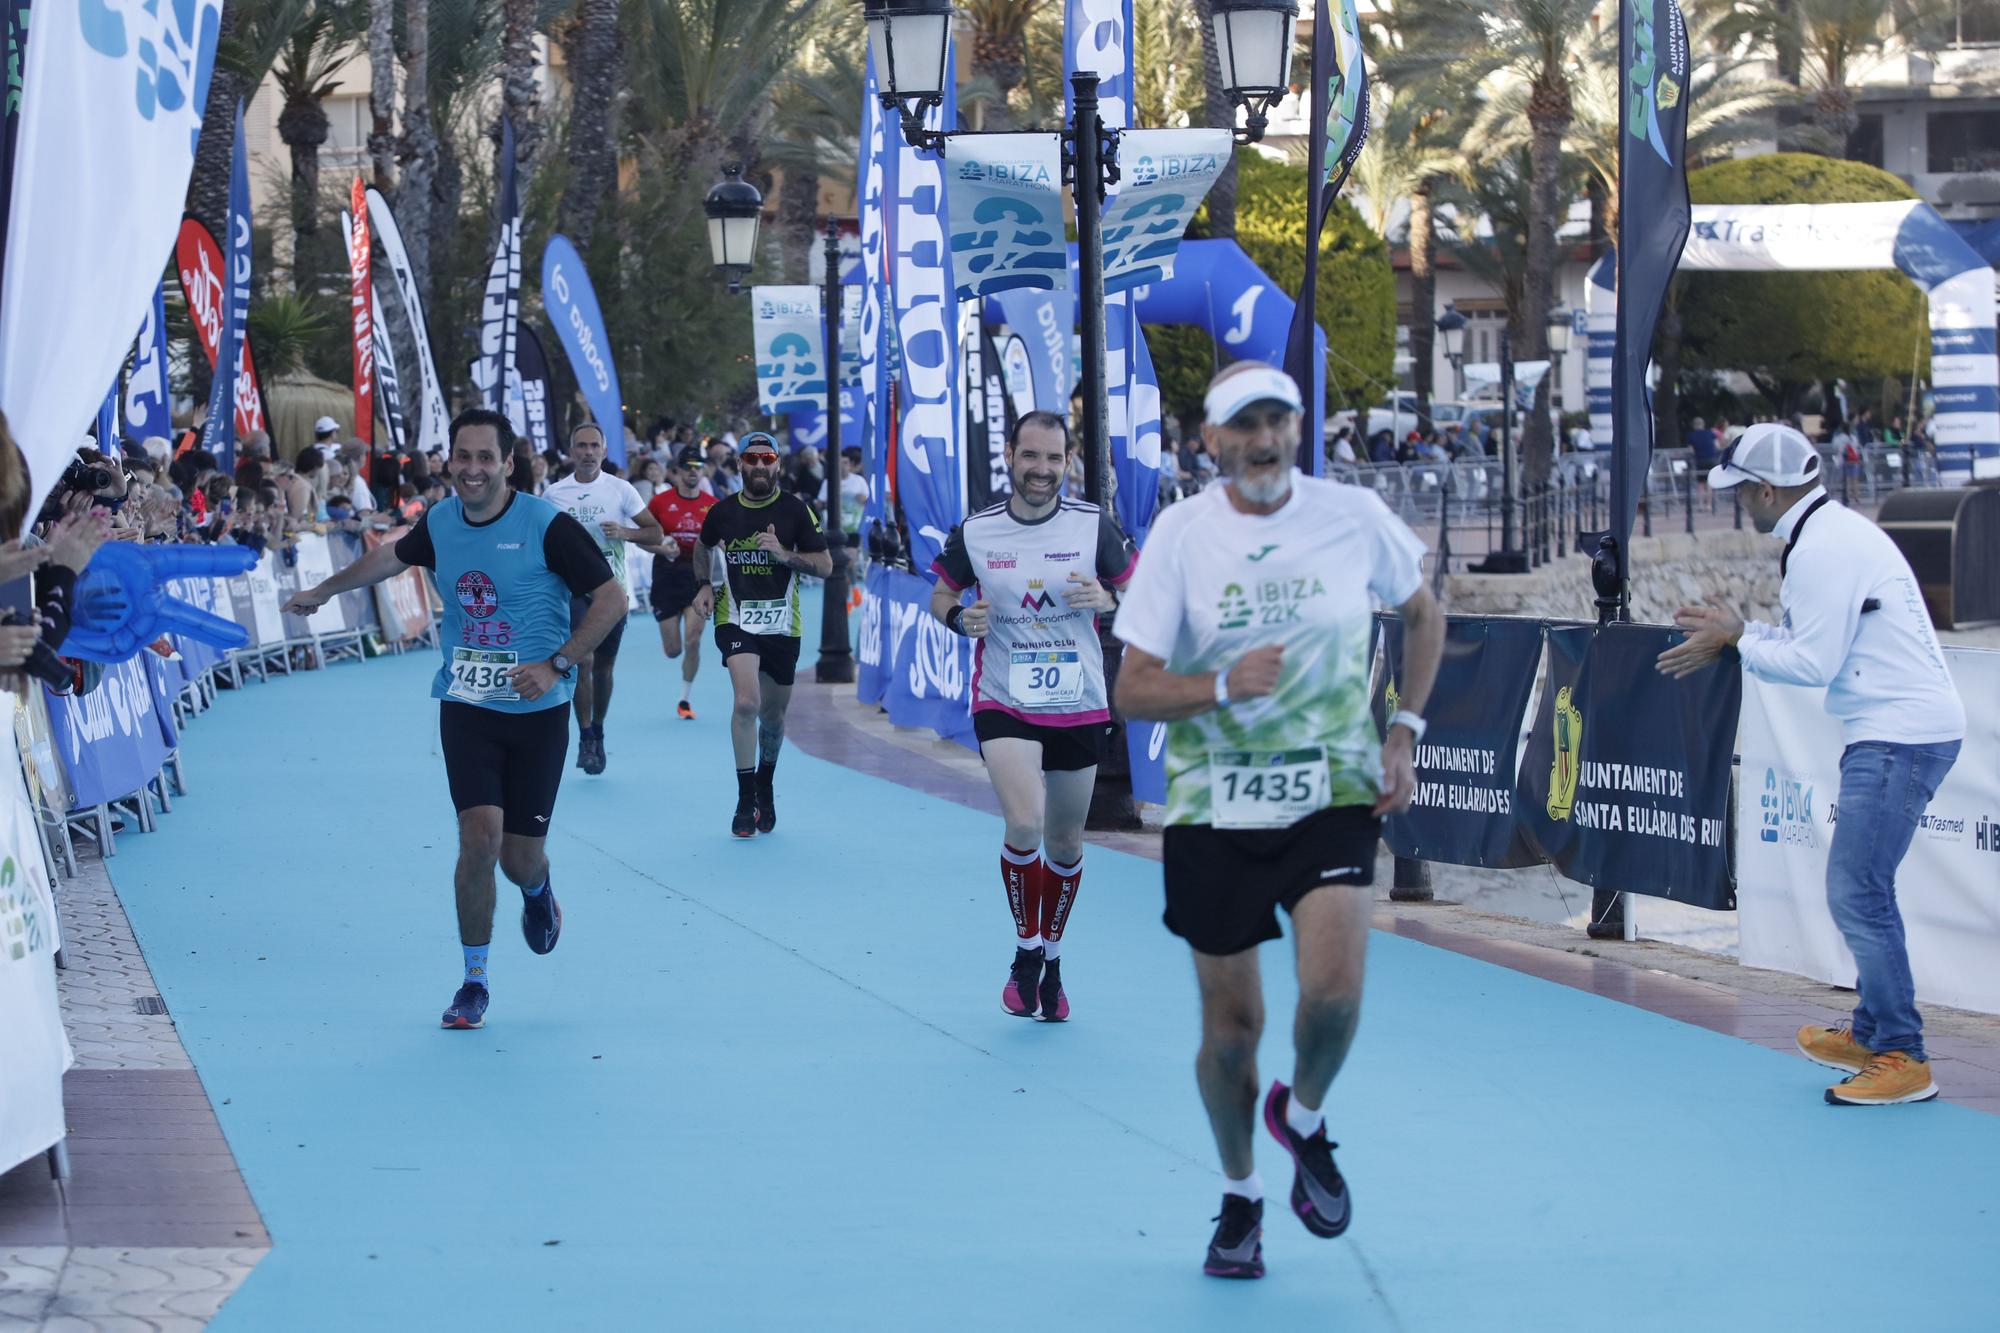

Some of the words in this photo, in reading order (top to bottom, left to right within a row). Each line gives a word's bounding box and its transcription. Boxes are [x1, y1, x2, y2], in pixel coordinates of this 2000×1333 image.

[1677, 38, 1686, 76] SANTA
[988, 165, 1050, 182] IBIZA
[1161, 157, 1217, 176] IBIZA
[988, 177, 1051, 192] MARATHON
[776, 303, 814, 315] IBIZA
[579, 506, 606, 517] IBIZA
[727, 551, 768, 565] SENSACI
[742, 565, 773, 575] uvex
[1257, 577, 1326, 603] IBIZA
[742, 610, 782, 625] 2257
[997, 614, 1031, 625] Método
[1034, 611, 1081, 624] Fenómeno
[1261, 603, 1302, 625] 22K
[1012, 641, 1052, 649] RUNNING
[456, 664, 508, 688] 1436
[1028, 667, 1060, 689] 30
[1412, 744, 1480, 772] JUNTAMENT
[1482, 749, 1495, 775] DE
[1222, 770, 1311, 802] 1435
[1669, 770, 1684, 799] DE
[1410, 781, 1446, 809] ANTA
[1780, 778, 1814, 824] IBIZA
[1574, 801, 1622, 832] SANTA
[1627, 800, 1678, 841] EULÀRIA
[1701, 817, 1722, 848] RIU
[1928, 815, 1964, 833] Trasmed
